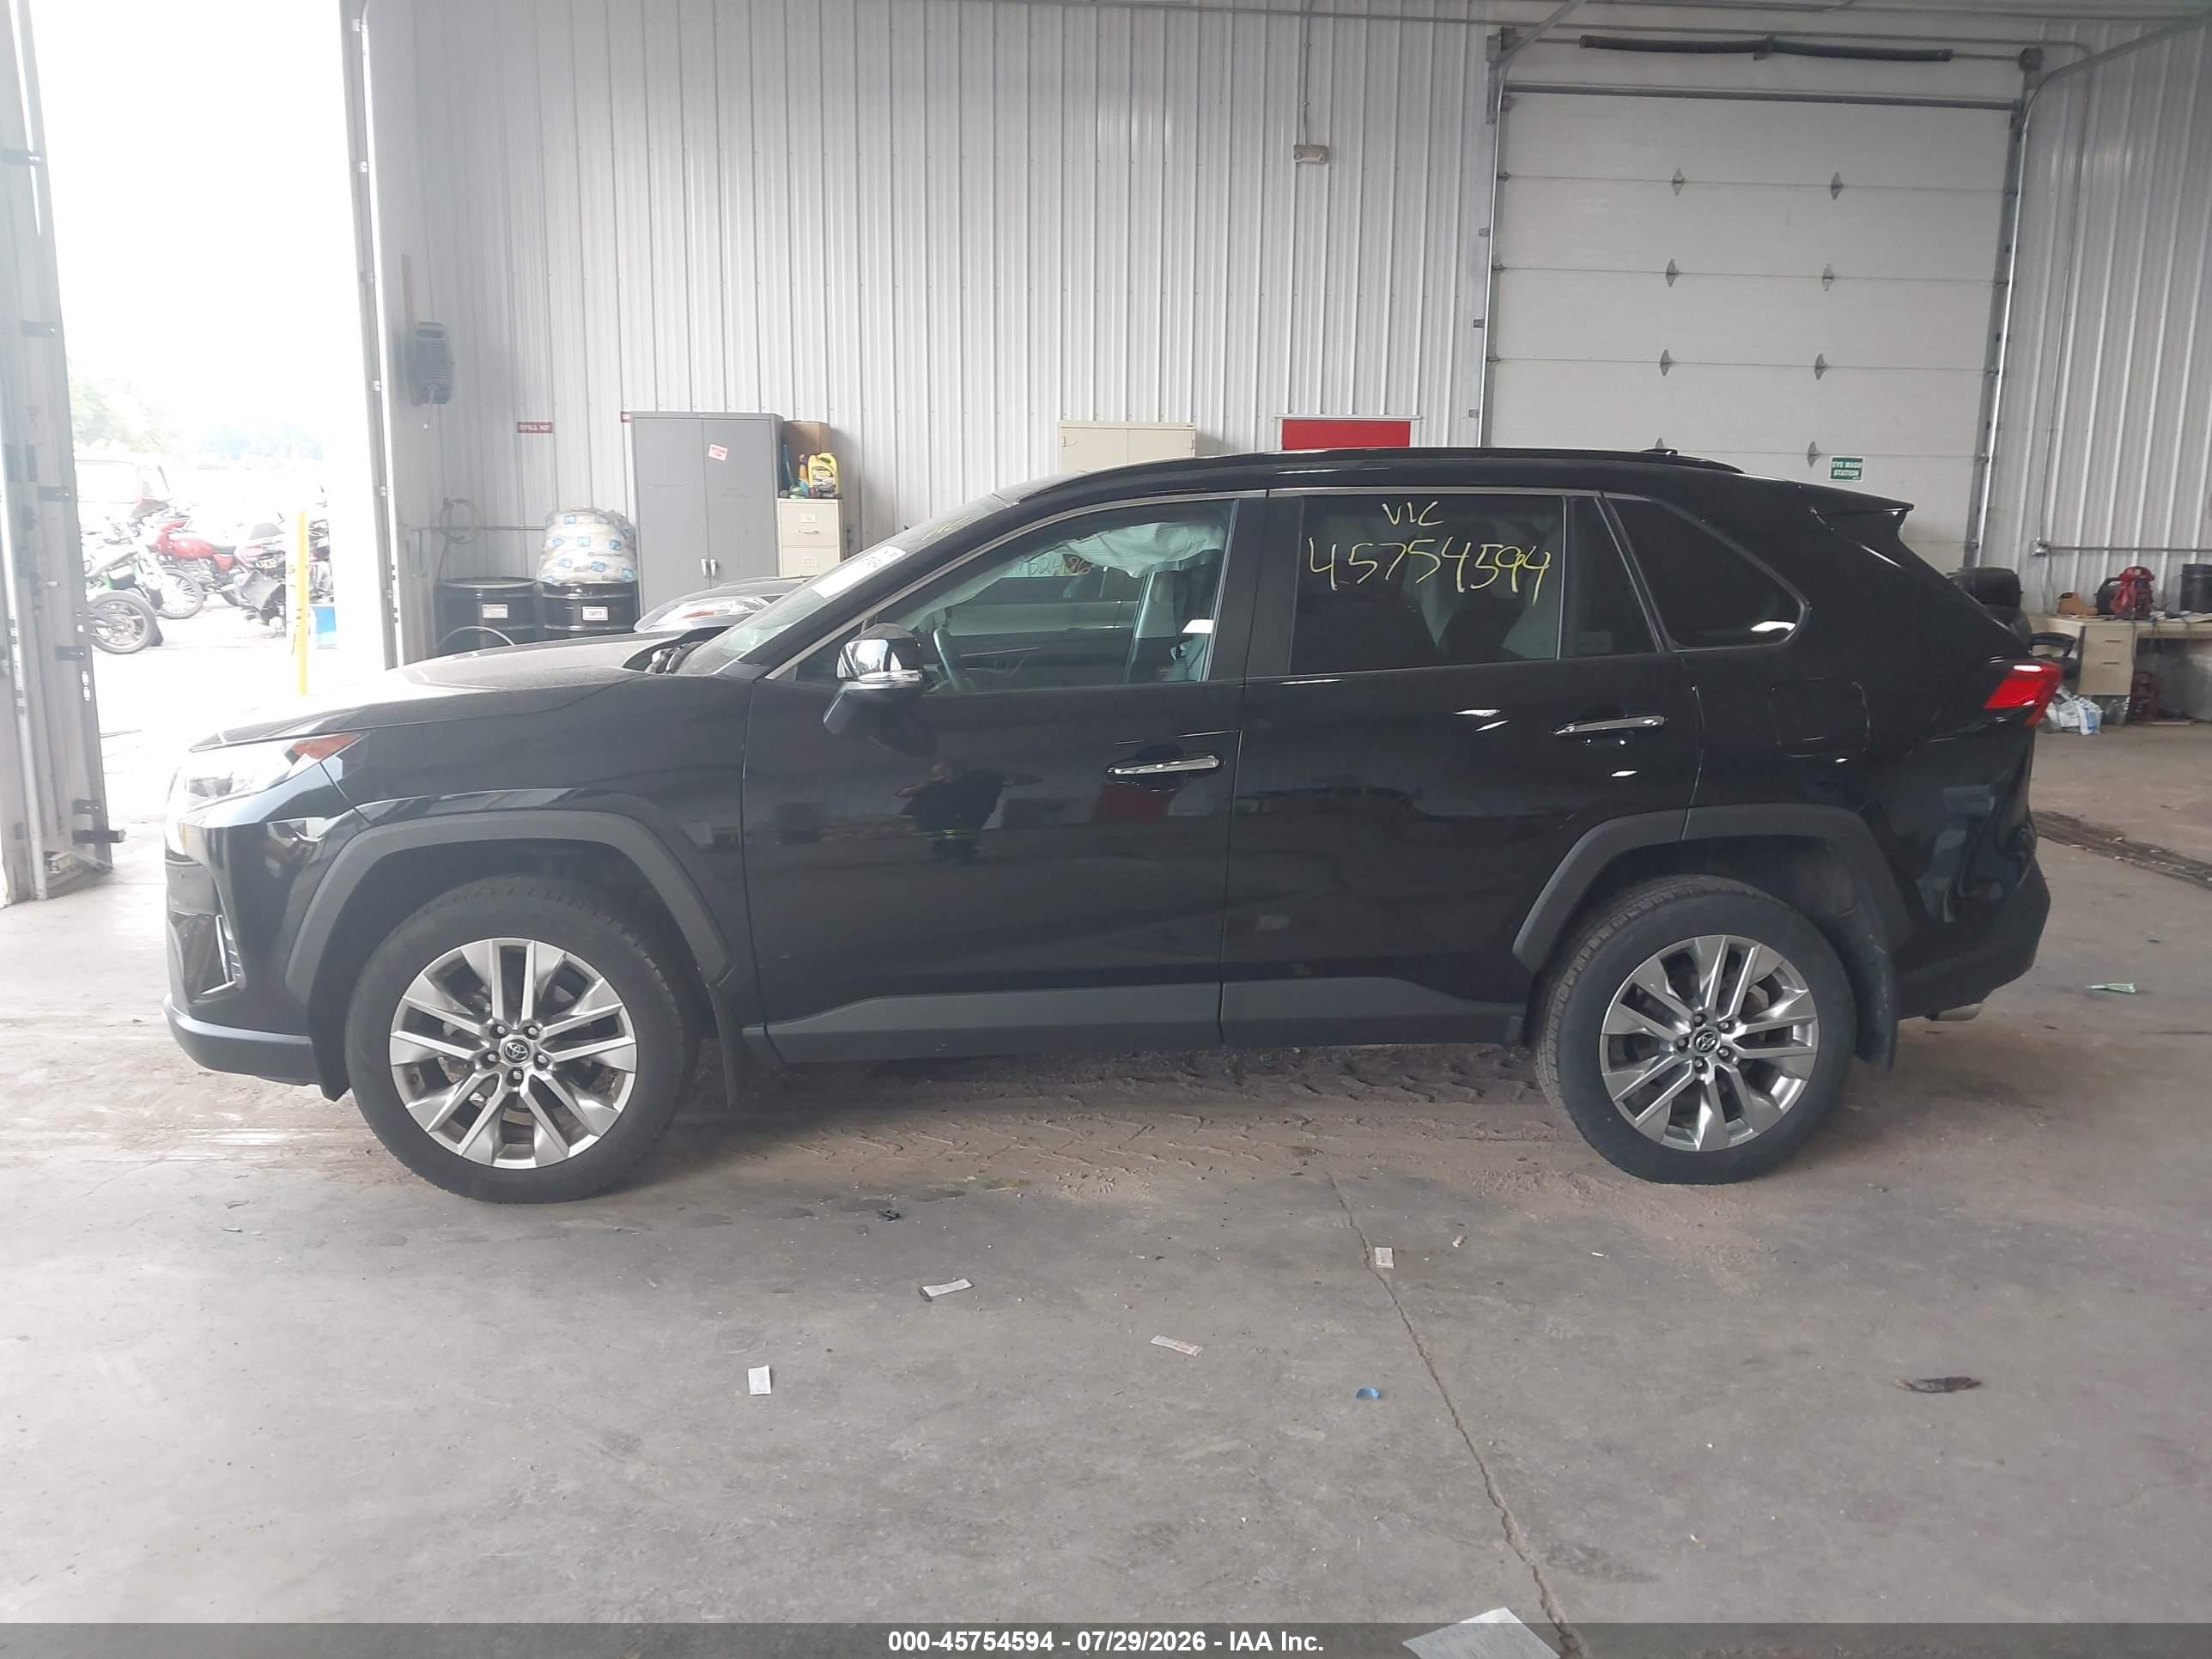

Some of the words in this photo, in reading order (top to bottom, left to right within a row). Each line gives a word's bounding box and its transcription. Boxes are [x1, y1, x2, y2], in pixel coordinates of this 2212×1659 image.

[1832, 460, 1844, 469] EYE
[1382, 501, 1444, 526] VIC
[1308, 536, 1552, 606] 45754594
